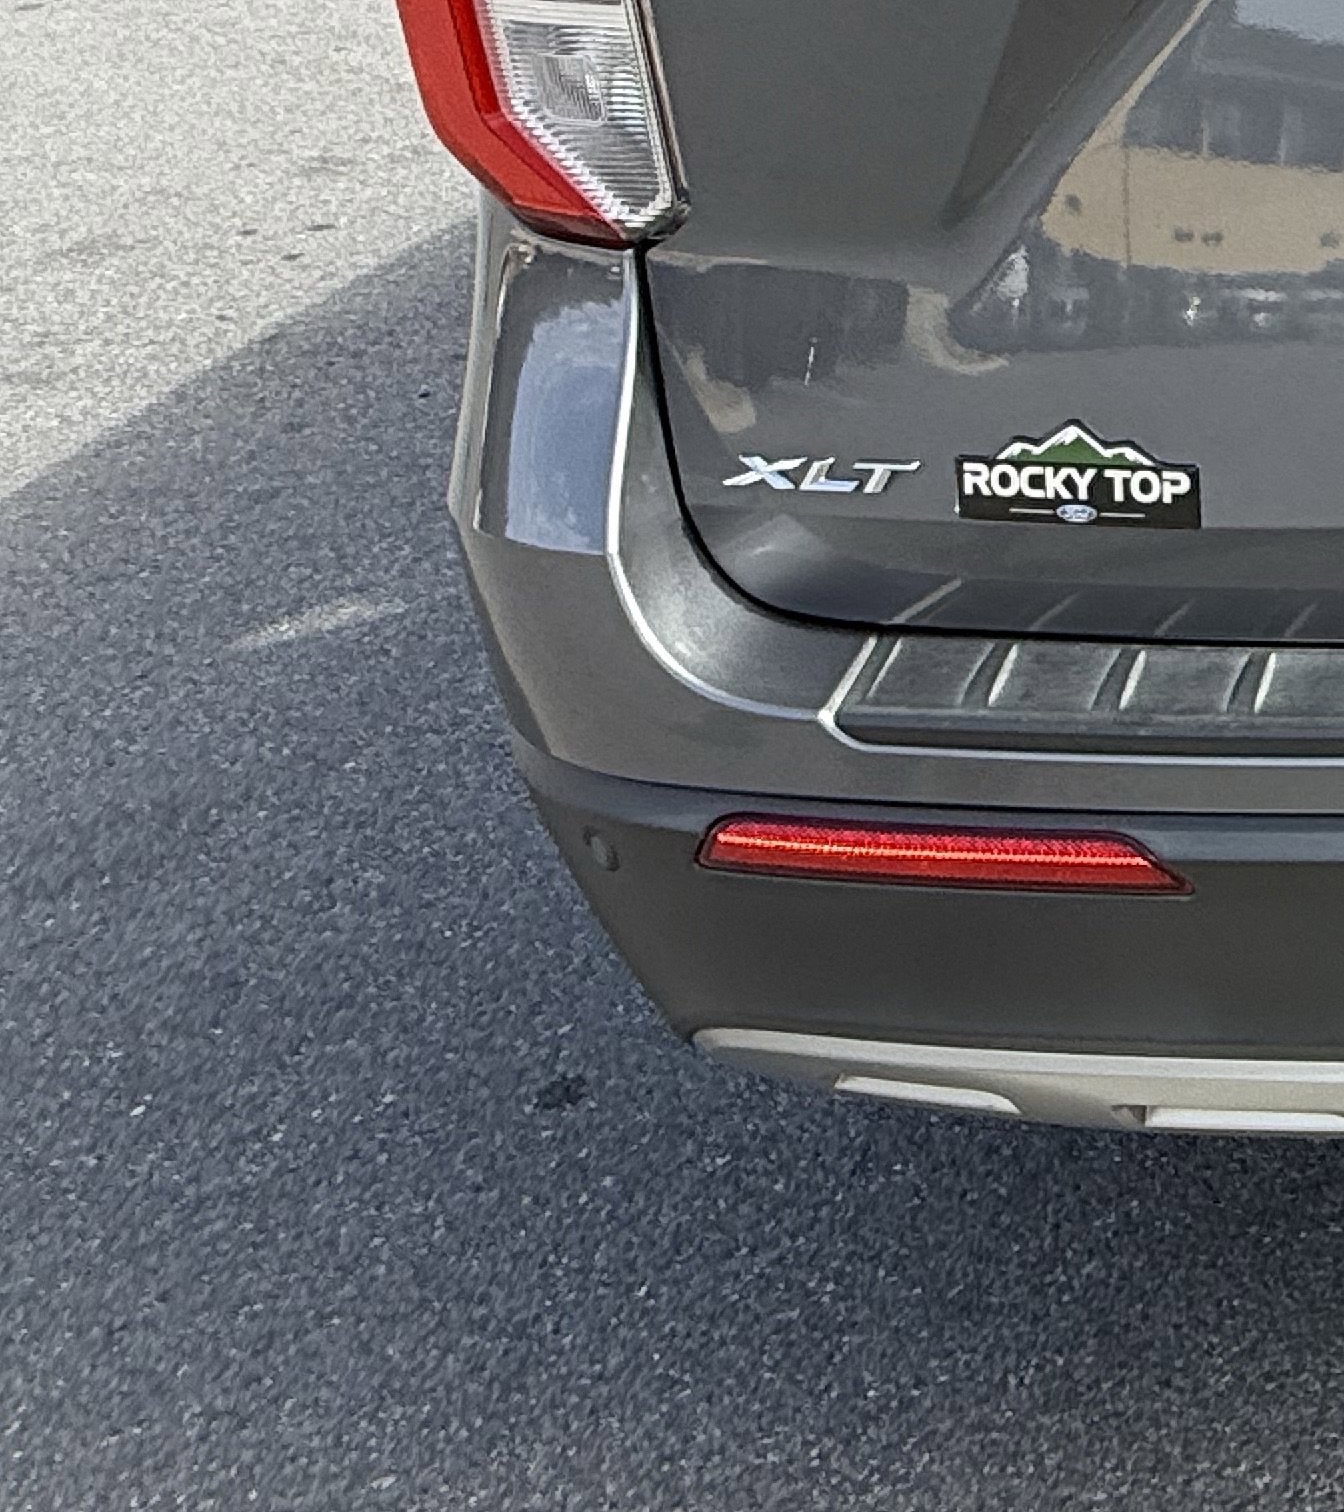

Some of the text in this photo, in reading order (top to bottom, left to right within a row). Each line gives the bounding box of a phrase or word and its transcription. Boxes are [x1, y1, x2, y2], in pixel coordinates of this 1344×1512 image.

[722, 454, 922, 495] XLT
[961, 461, 1192, 504] ROCKY TOP
